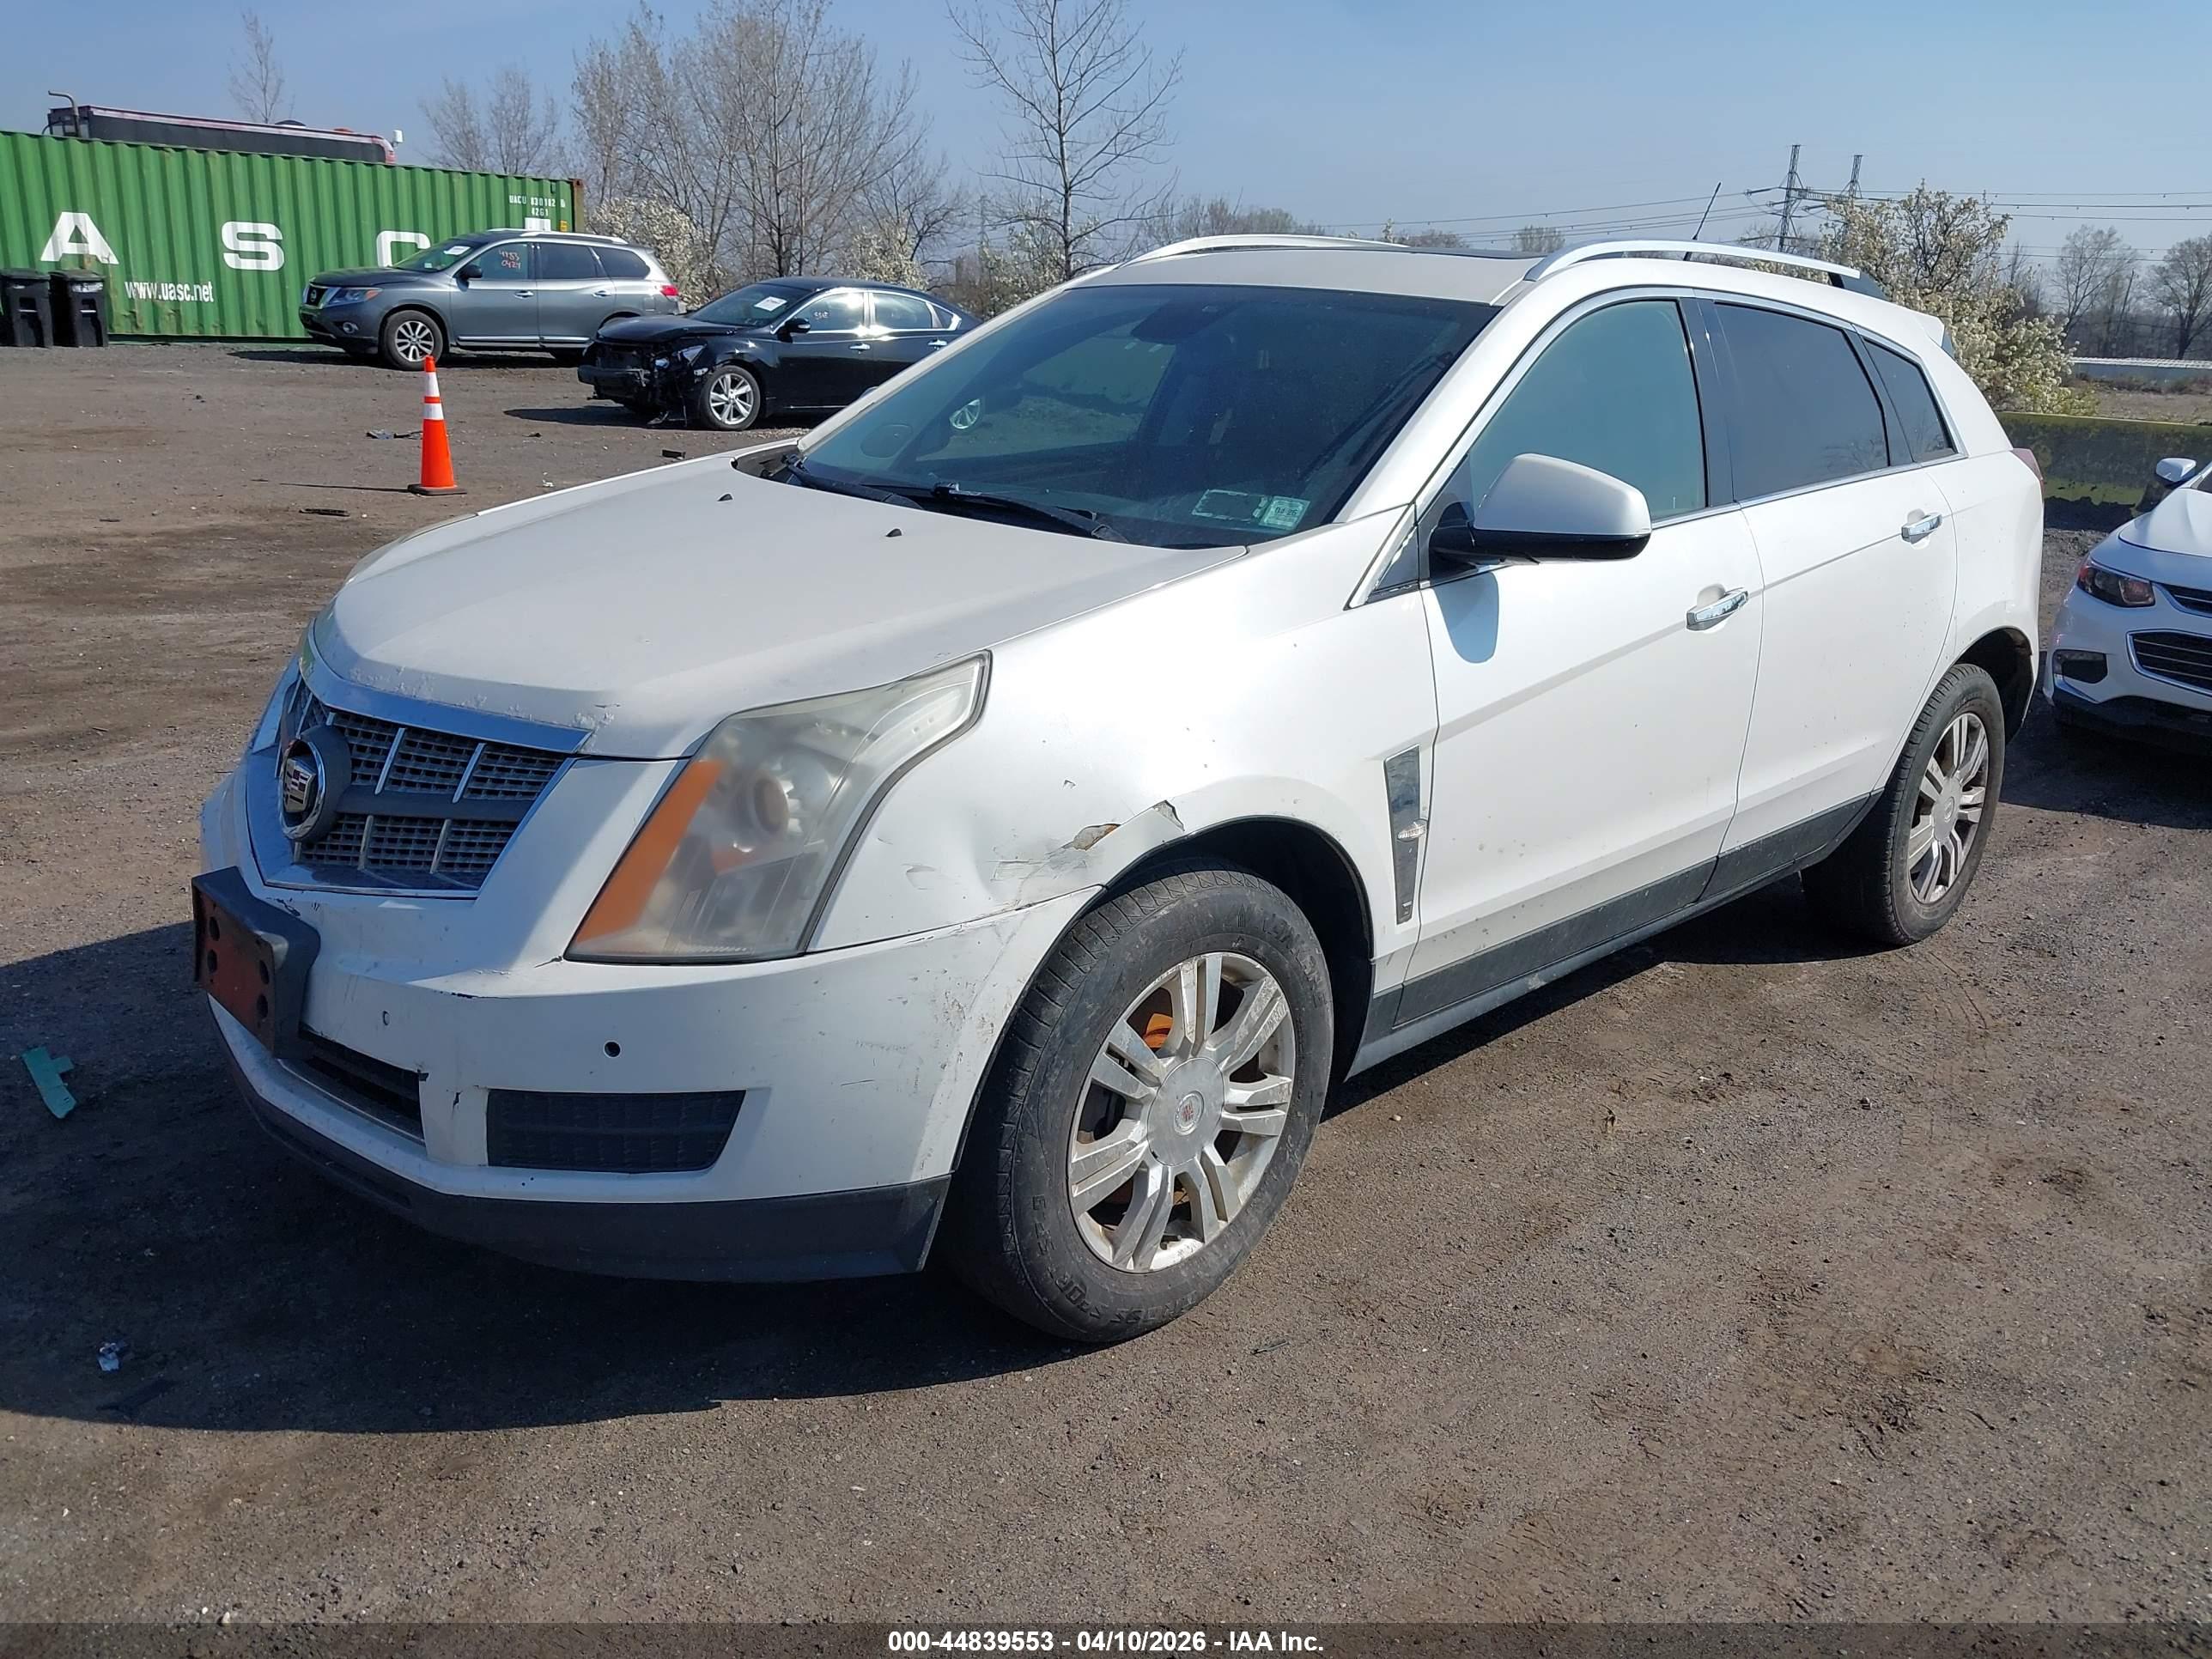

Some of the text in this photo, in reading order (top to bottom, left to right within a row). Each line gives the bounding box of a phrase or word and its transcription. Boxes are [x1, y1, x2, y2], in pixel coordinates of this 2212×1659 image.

[40, 211, 119, 264] A
[222, 221, 285, 271] S
[124, 281, 214, 302] www.uasc.net
